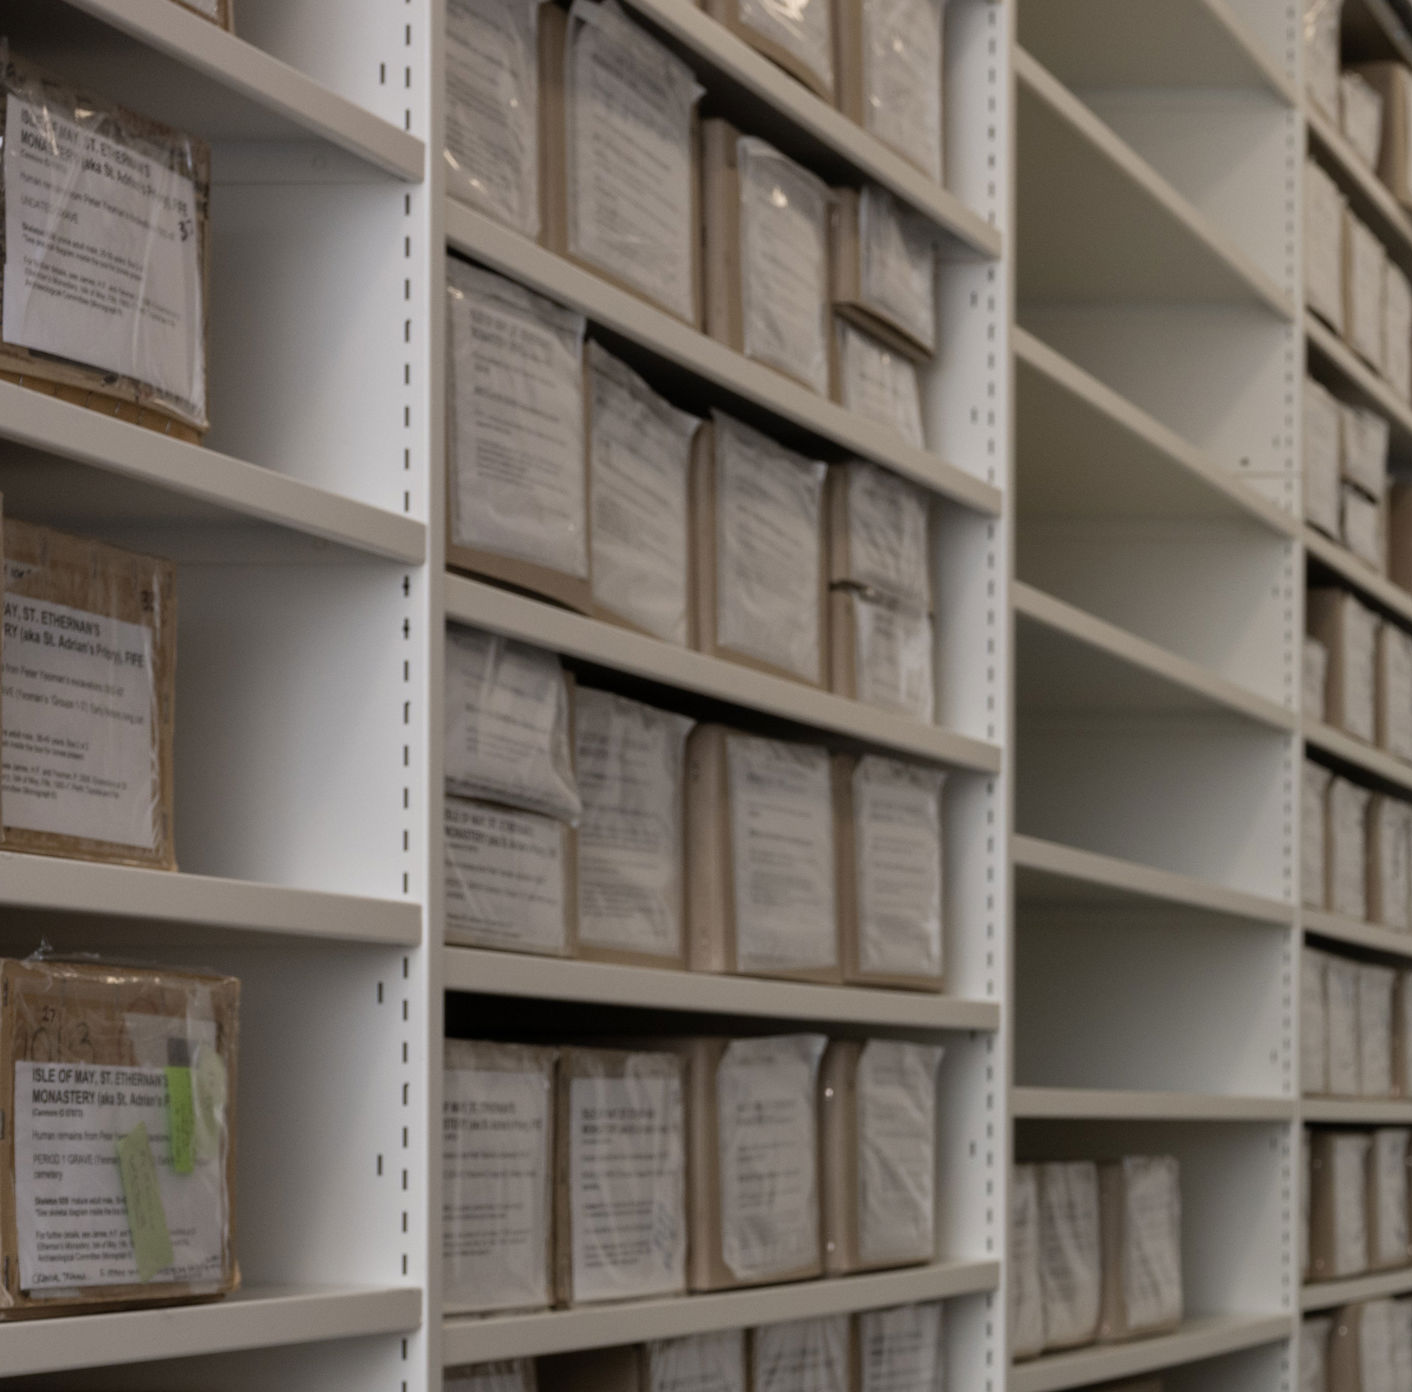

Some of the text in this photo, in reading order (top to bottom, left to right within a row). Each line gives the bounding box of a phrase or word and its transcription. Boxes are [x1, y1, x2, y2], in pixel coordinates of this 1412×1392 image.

[3, 602, 23, 621] AY,
[23, 605, 39, 623] ST.
[43, 631, 57, 648] St.
[32, 1068, 56, 1083] ISLE
[58, 1069, 73, 1084] OF
[75, 1070, 98, 1087] MAY,
[100, 1071, 114, 1087] ST.
[32, 1088, 96, 1105] MONASTERY
[116, 1091, 129, 1107] St.
